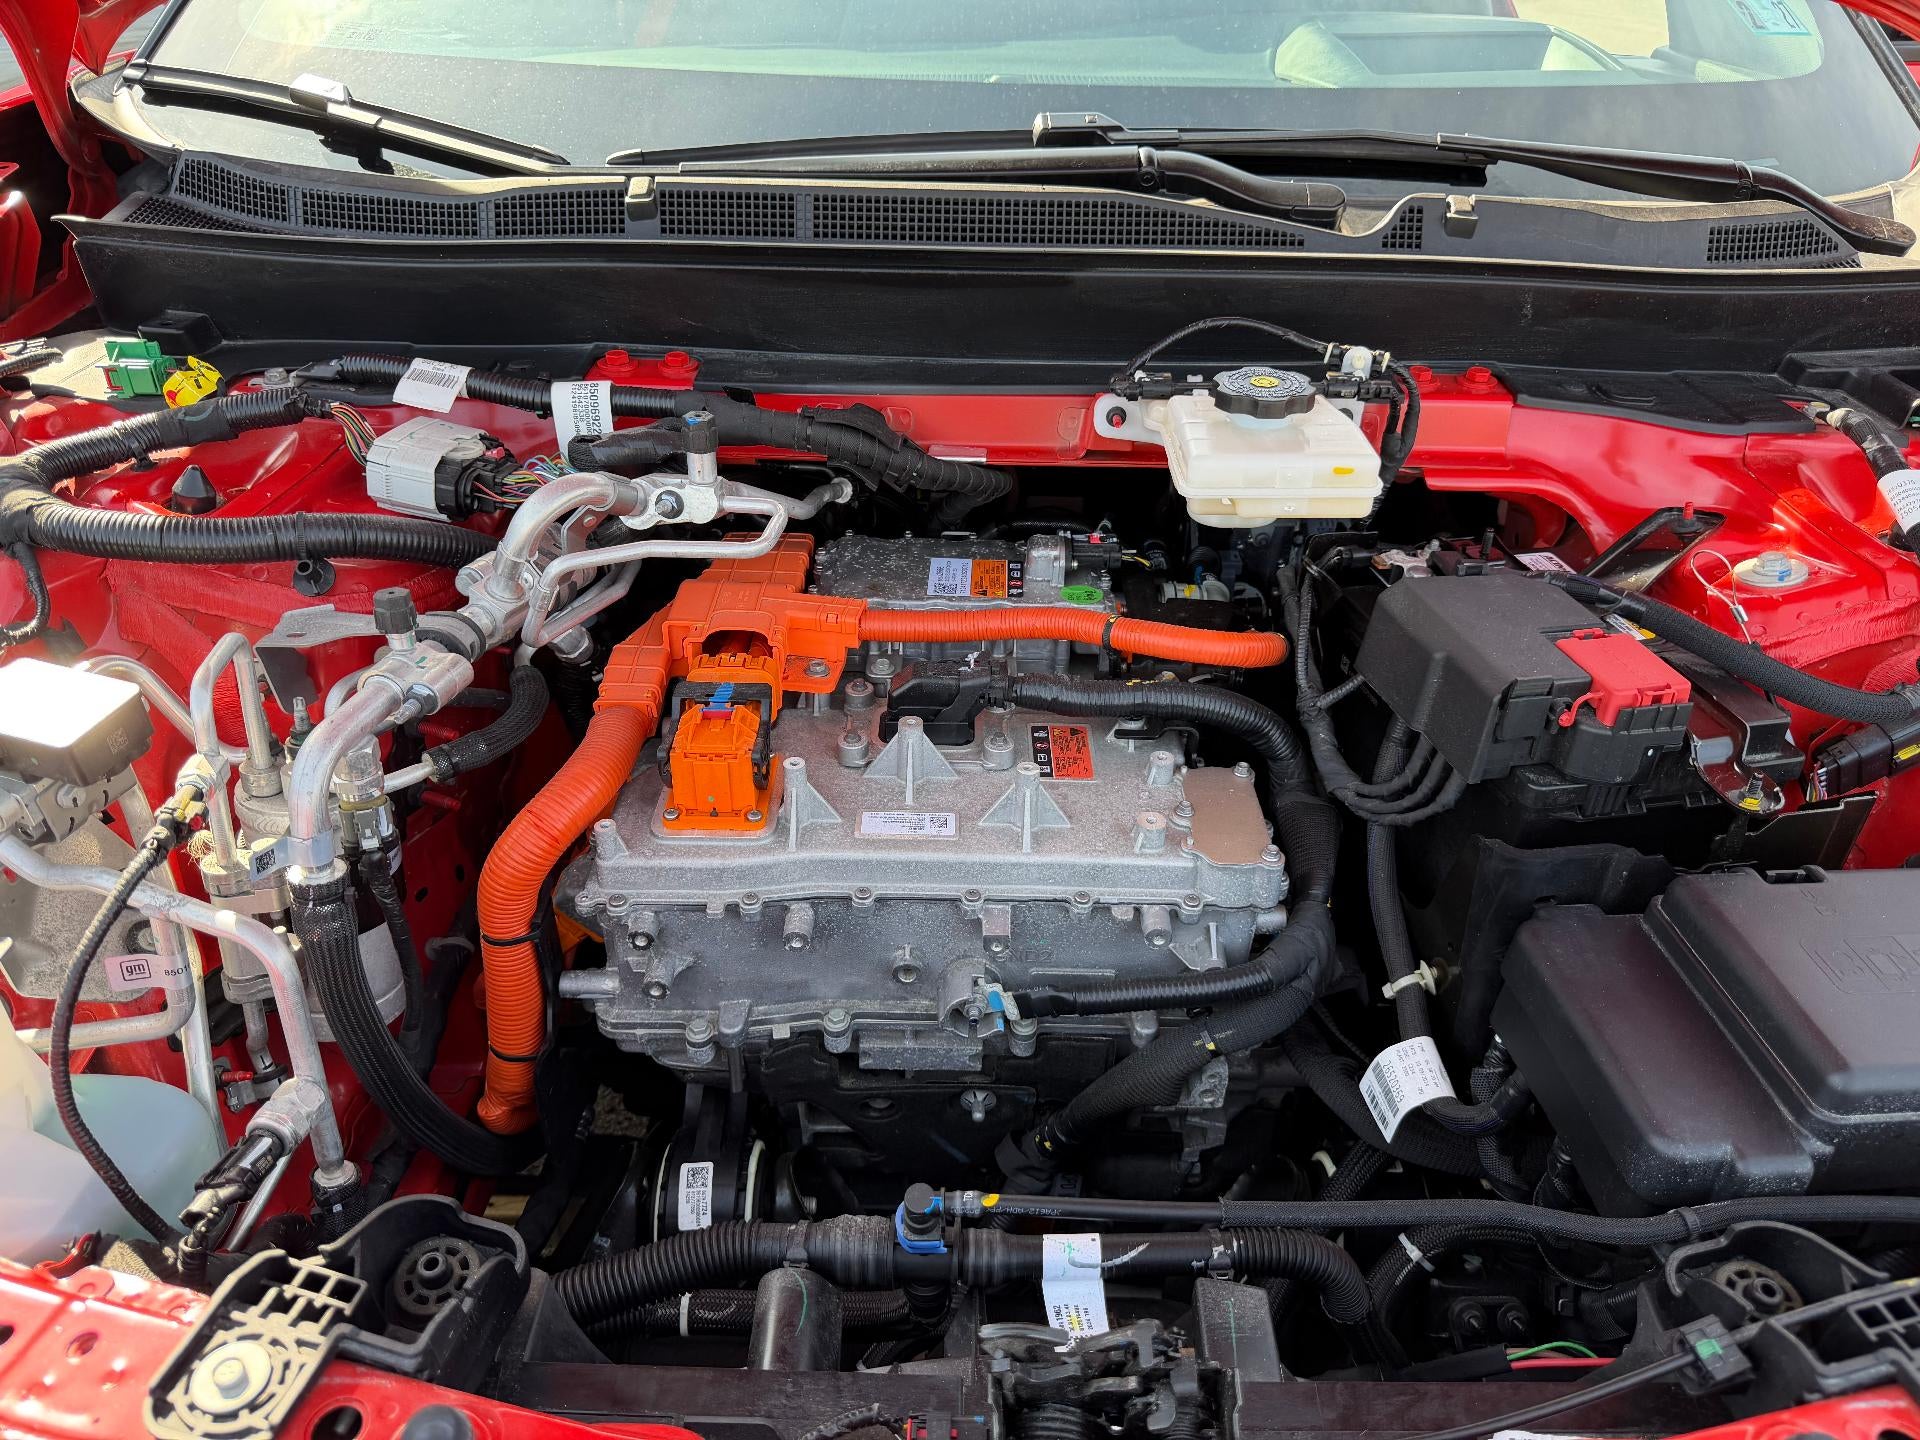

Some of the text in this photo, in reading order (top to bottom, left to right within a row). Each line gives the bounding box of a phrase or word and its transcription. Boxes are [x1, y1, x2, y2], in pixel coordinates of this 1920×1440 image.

[589, 382, 603, 435] 85096922
[125, 963, 190, 977] gm 8501
